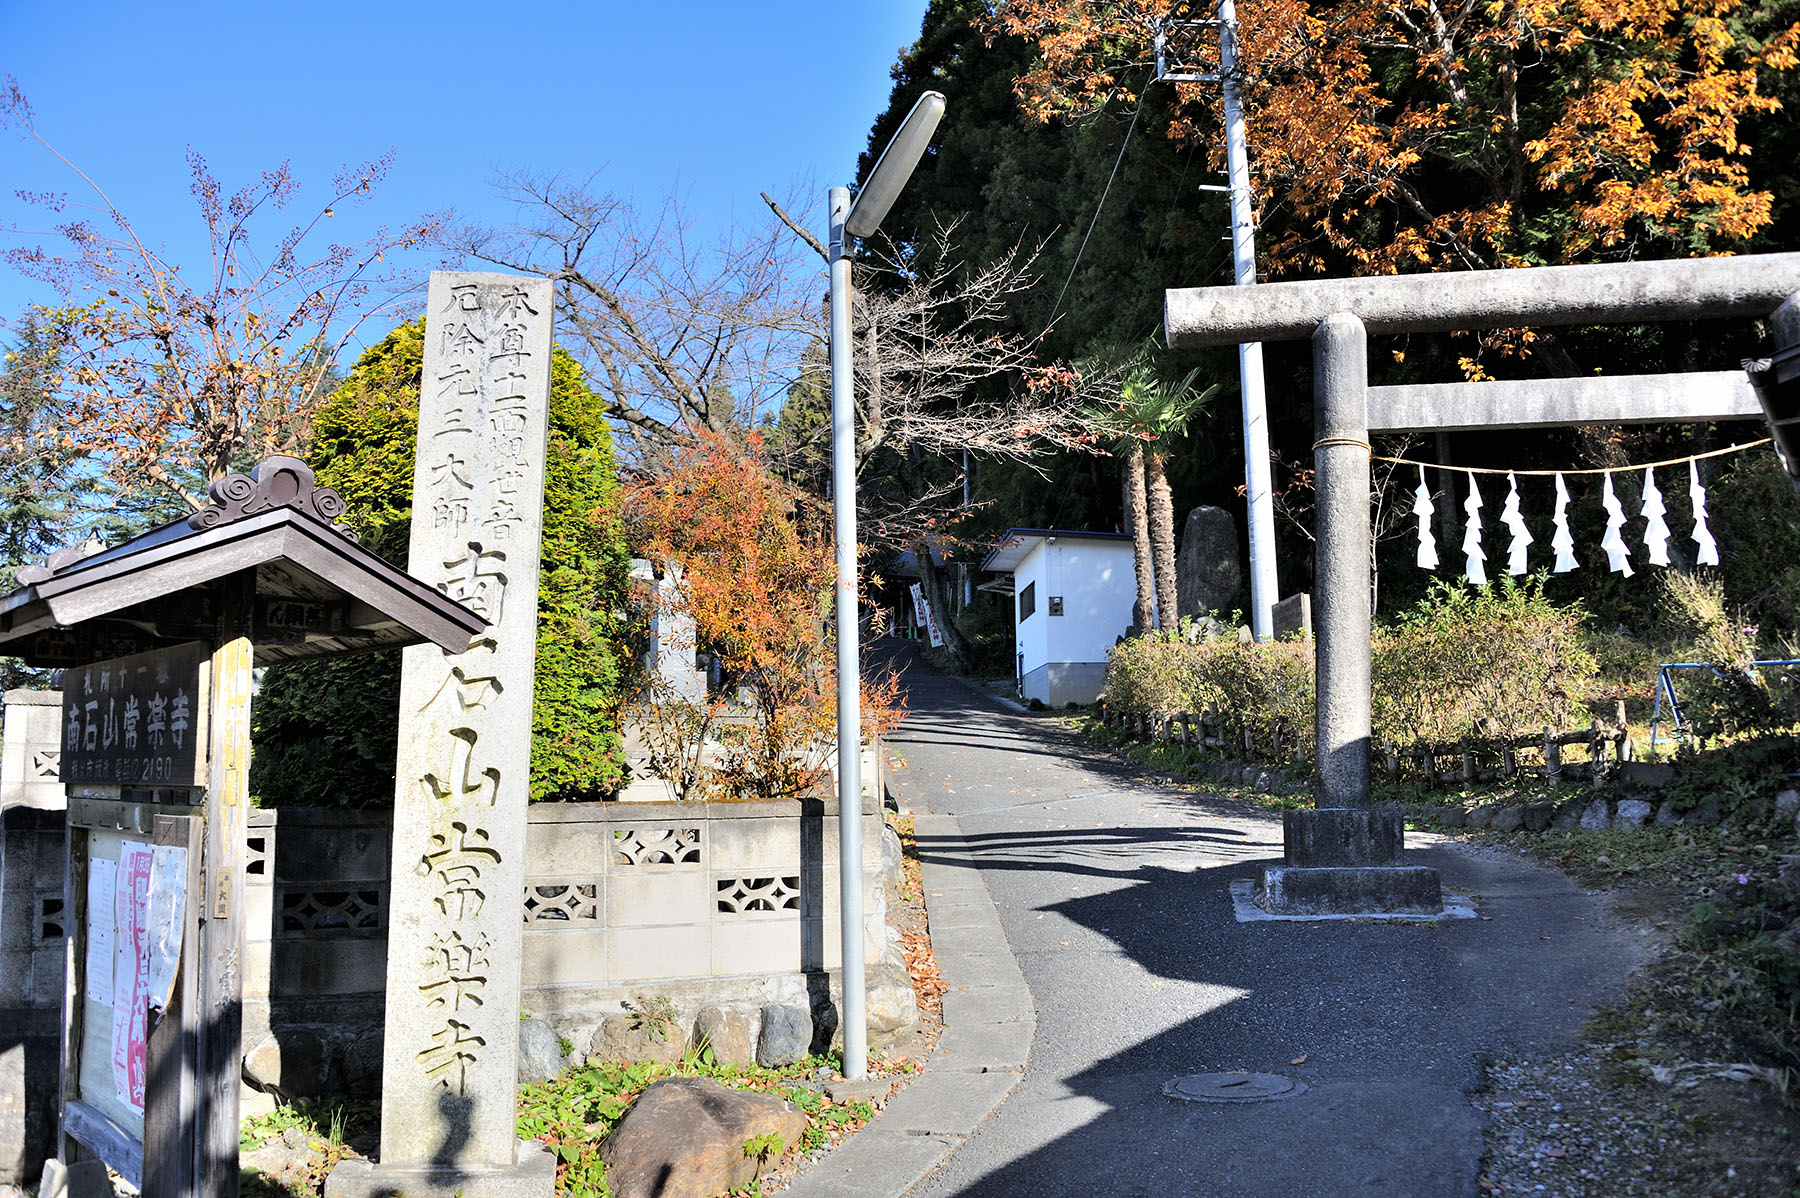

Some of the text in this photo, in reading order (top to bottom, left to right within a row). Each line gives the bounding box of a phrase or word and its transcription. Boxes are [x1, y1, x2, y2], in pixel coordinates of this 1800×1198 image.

[431, 284, 485, 539] 厄除元三大師
[67, 687, 191, 753] 南石山常楽寺
